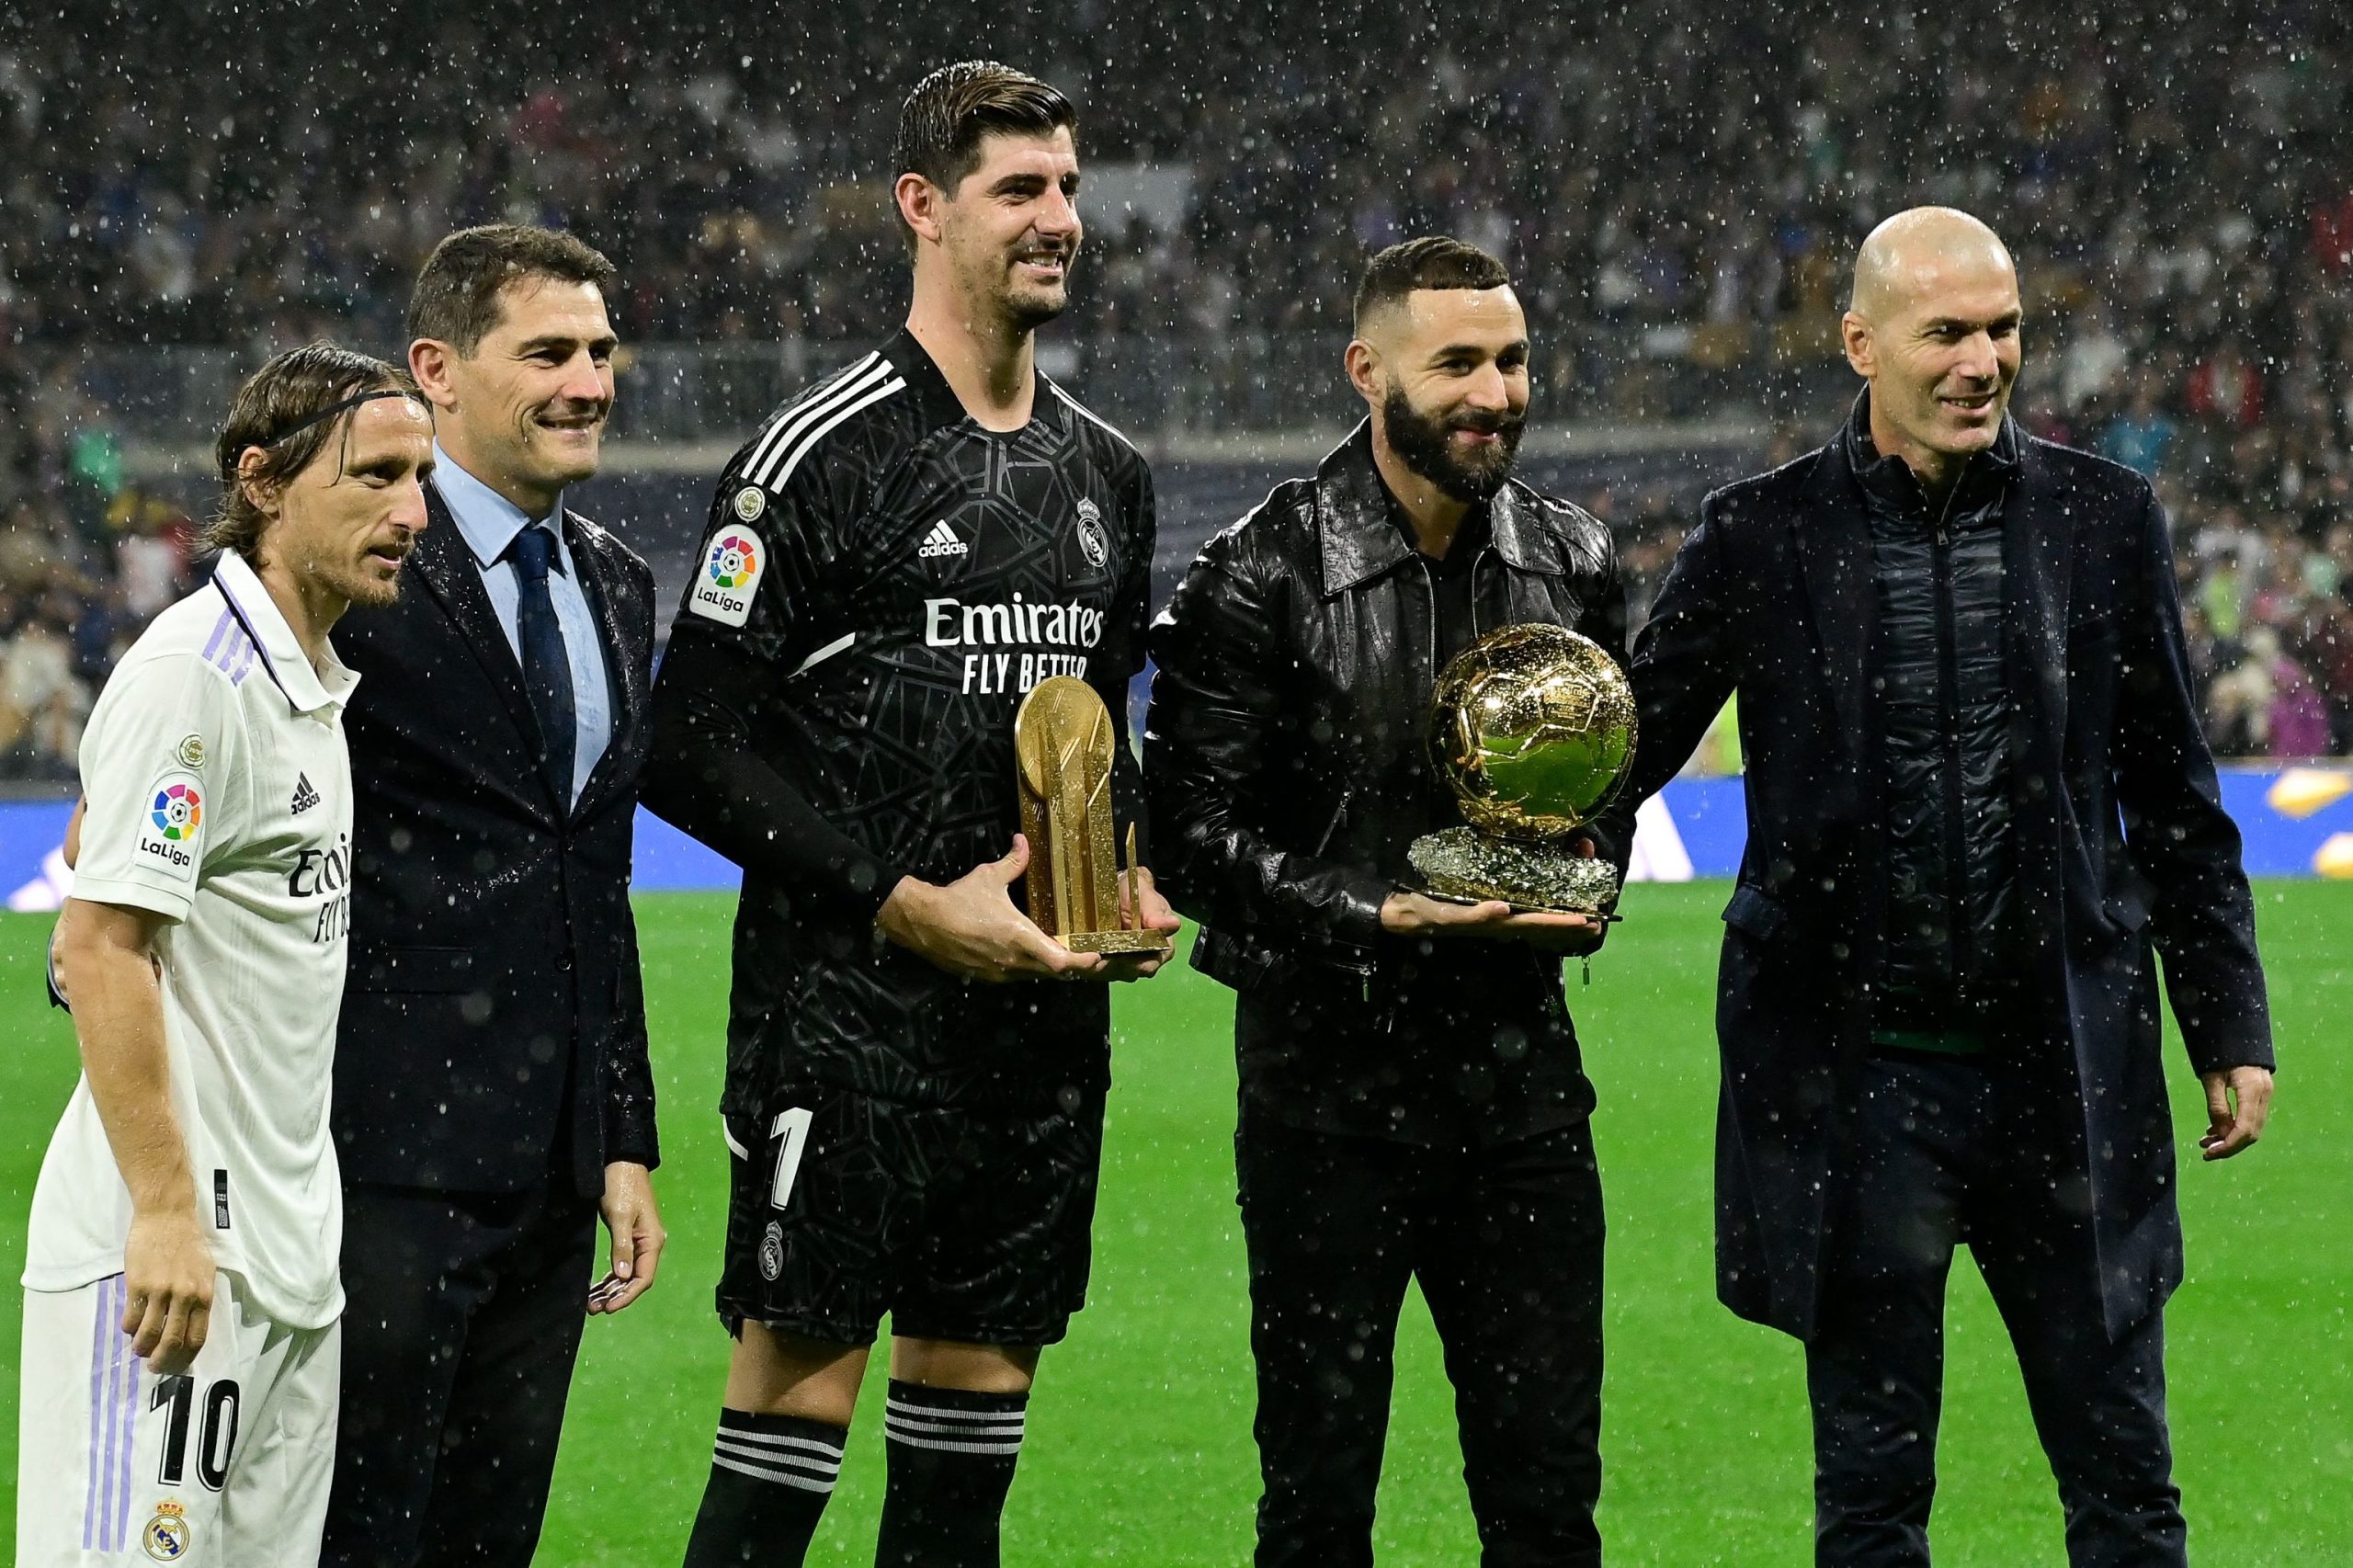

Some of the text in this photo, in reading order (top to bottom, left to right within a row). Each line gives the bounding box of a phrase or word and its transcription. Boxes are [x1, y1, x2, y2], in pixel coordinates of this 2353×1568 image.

[918, 541, 969, 558] adidas
[697, 586, 745, 612] LaLiga
[924, 591, 1104, 649] Emirates
[961, 653, 1011, 695] FLY
[141, 837, 190, 867] LaLiga
[769, 1107, 813, 1211] 1
[149, 1374, 240, 1493] 10
